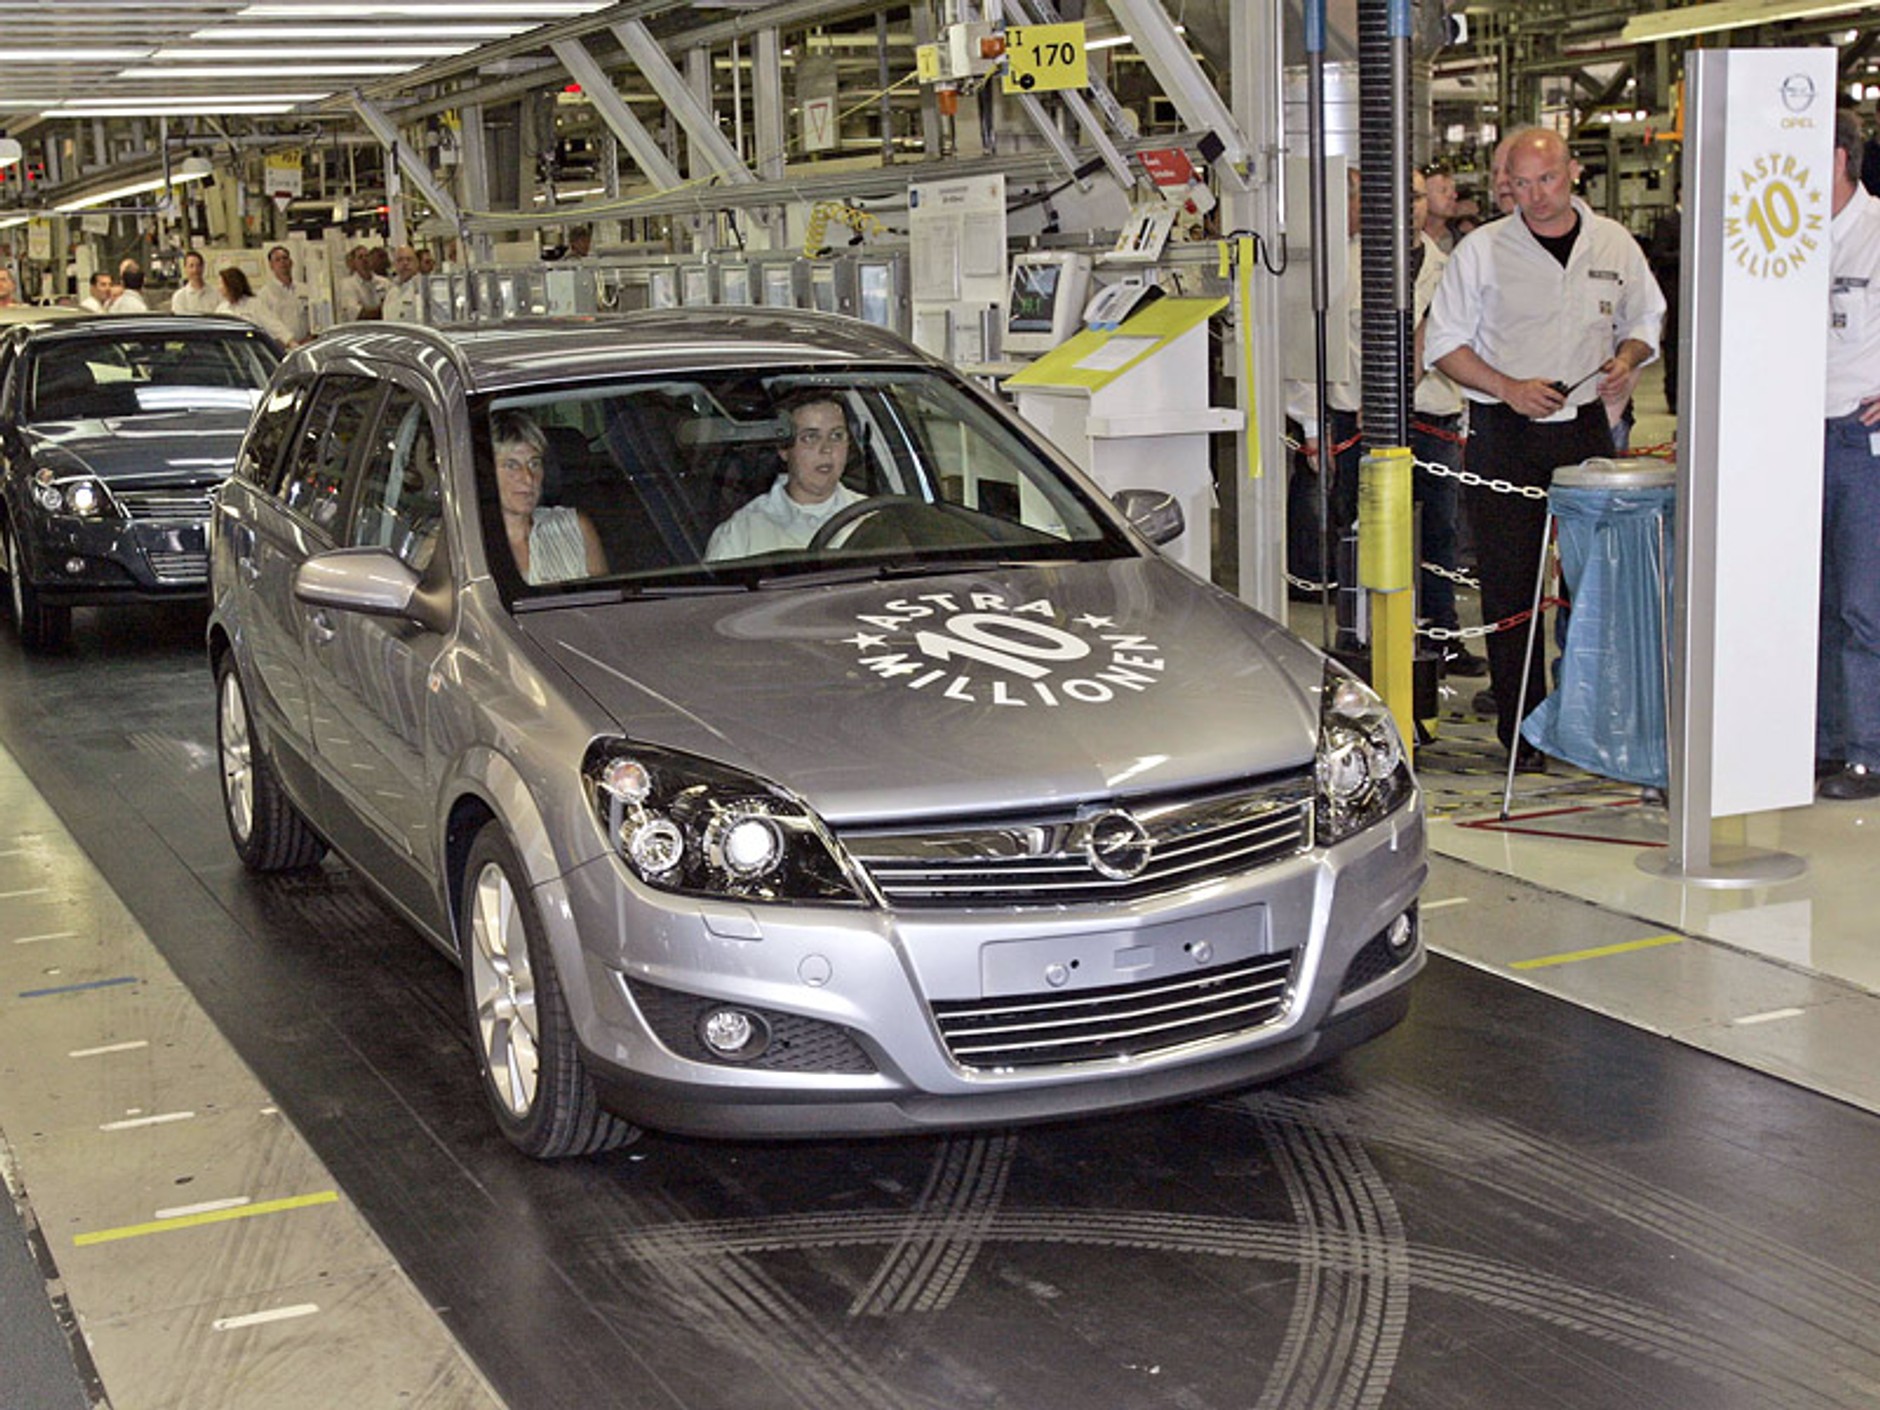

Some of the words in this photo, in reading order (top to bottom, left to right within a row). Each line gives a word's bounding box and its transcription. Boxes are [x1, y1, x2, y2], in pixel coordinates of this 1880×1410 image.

[1032, 42, 1075, 67] 170
[1781, 117, 1815, 129] OPEL
[1740, 153, 1809, 190] ASTRA
[1746, 180, 1800, 252] 10
[1725, 213, 1823, 278] MILLIONEN
[856, 592, 1055, 630] ASTRA
[858, 634, 1165, 706] MILLIONEN
[915, 613, 1091, 679] 10
